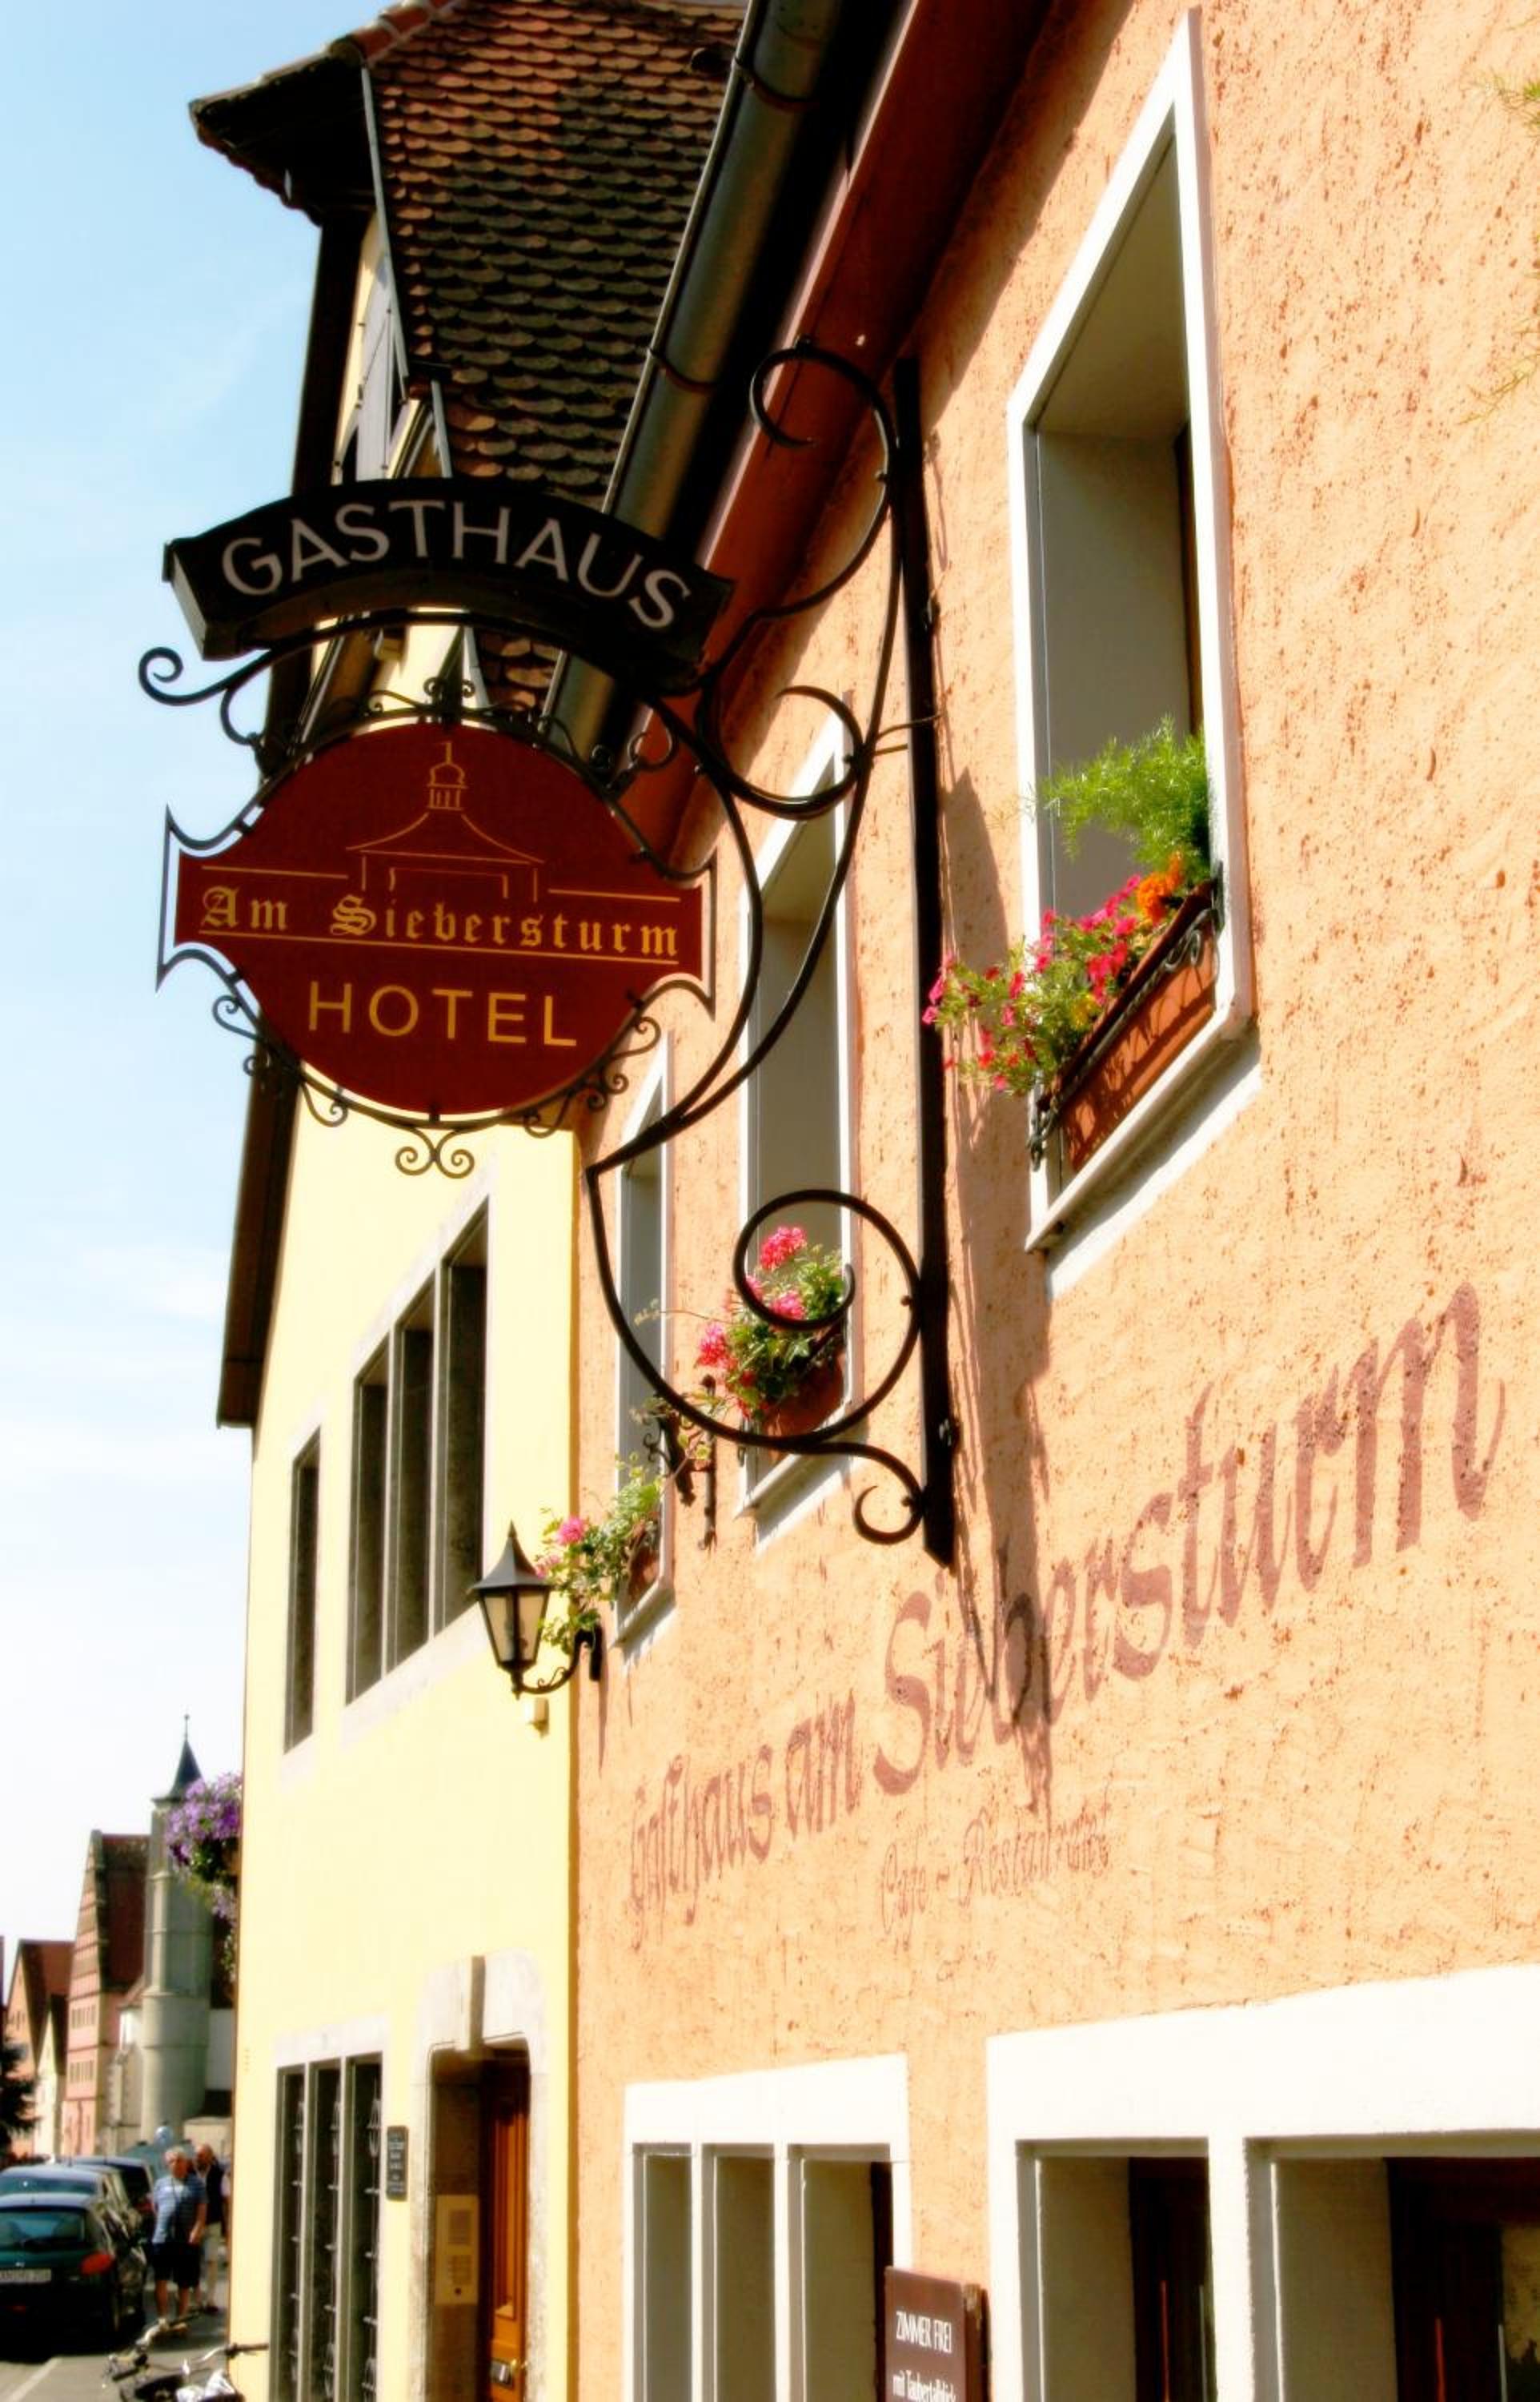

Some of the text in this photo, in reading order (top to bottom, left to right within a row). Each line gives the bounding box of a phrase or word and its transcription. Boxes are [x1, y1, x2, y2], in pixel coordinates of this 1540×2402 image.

[222, 500, 692, 630] GASTHAUS
[200, 886, 680, 957] Am Siebersturm
[309, 980, 577, 1047] HOTEL
[872, 1281, 1506, 1795] Siebersturm
[896, 2310, 952, 2354] ZIMMER FREI
